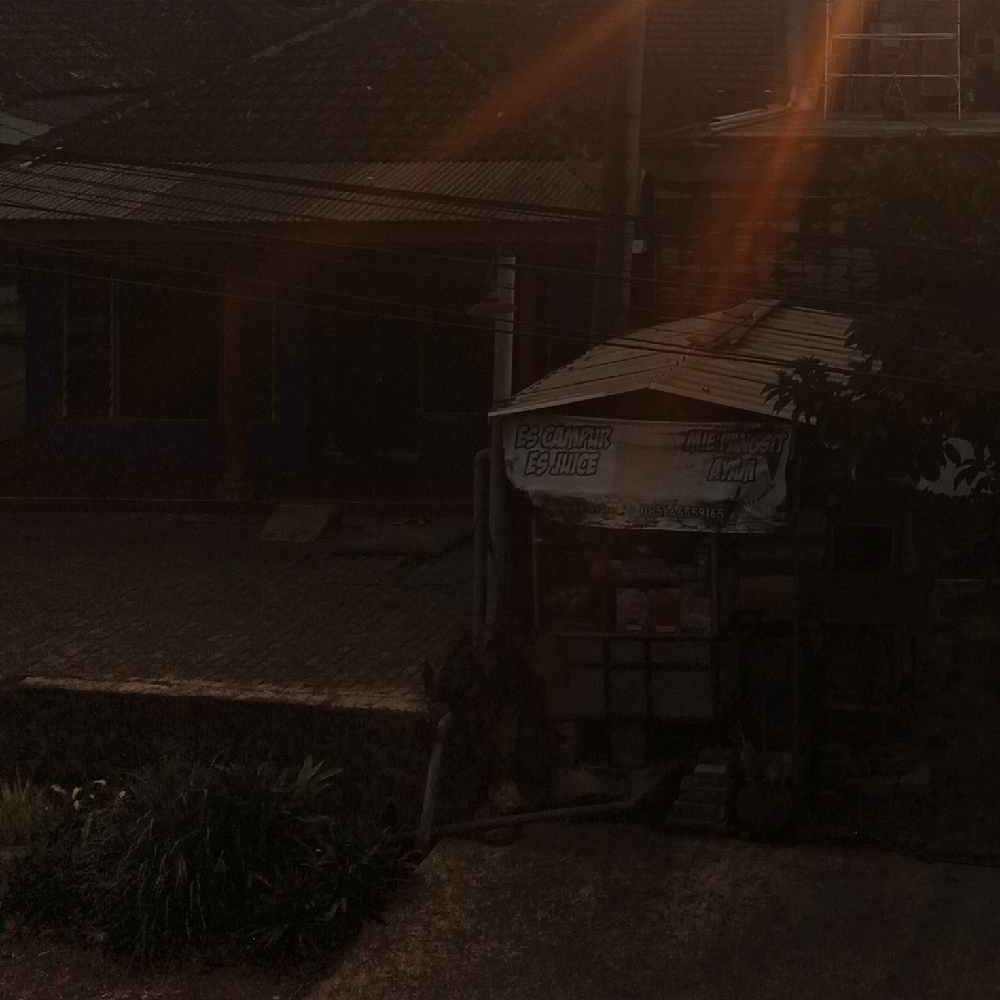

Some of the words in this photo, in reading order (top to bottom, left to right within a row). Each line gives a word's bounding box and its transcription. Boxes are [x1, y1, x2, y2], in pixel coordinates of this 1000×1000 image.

[515, 425, 539, 449] ES
[541, 425, 613, 450] CAMPUR
[683, 429, 717, 453] MIE
[525, 451, 550, 476] ES
[549, 451, 600, 476] JUICE
[707, 456, 757, 483] AYAM
